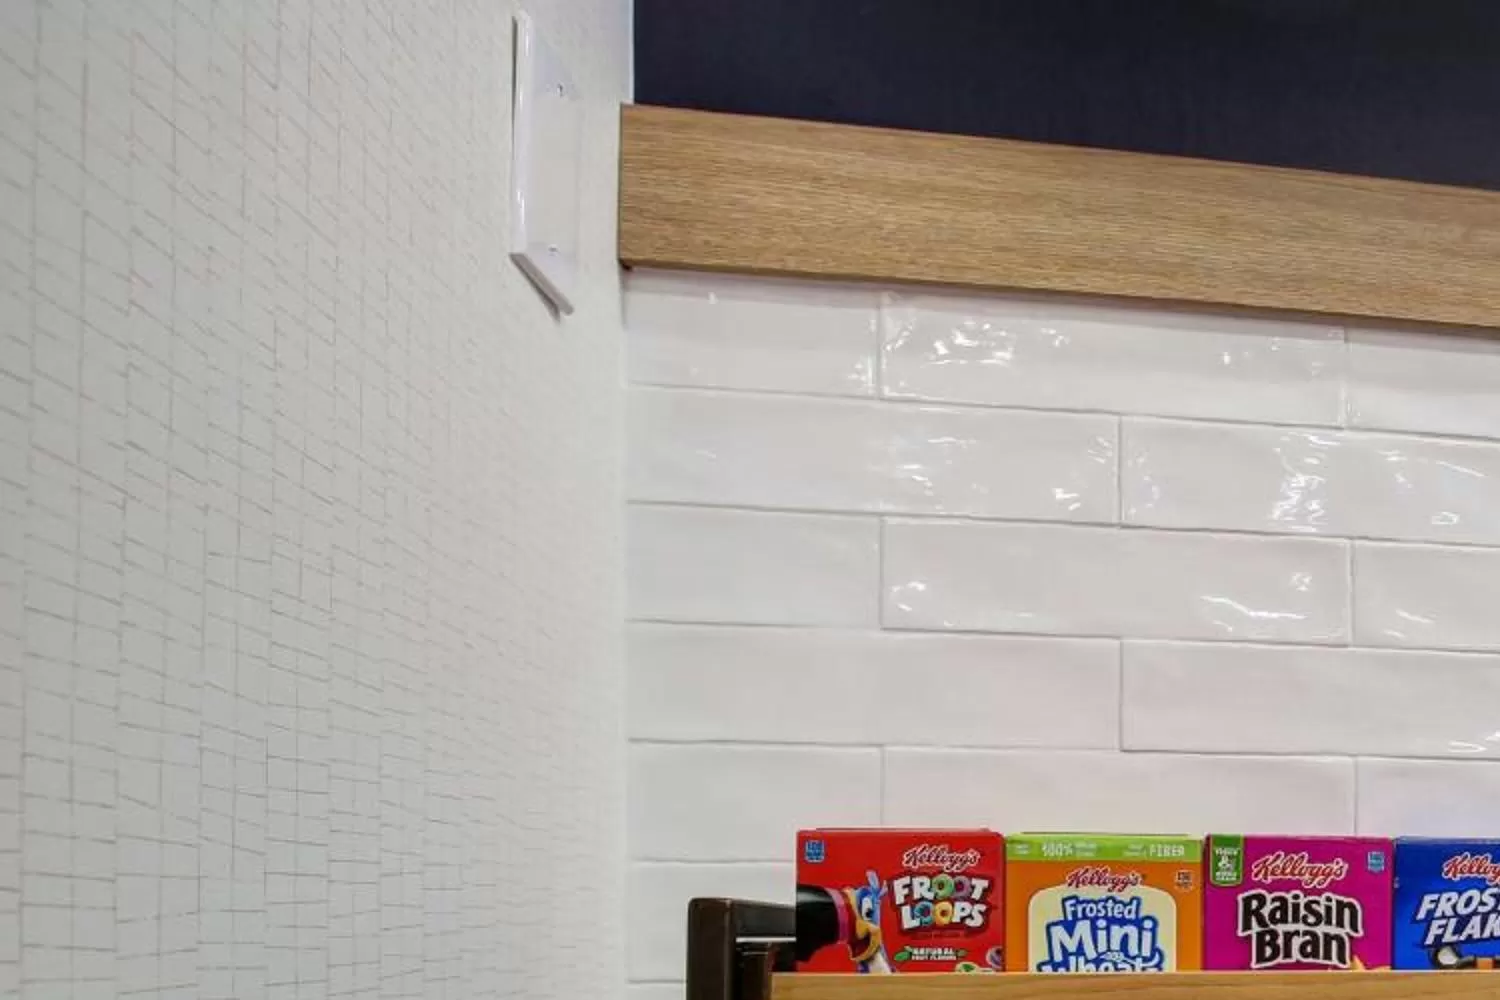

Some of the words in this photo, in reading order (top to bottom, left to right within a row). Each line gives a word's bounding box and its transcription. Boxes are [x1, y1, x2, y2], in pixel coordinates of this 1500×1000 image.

[903, 844, 980, 872] Kellogg's
[1252, 851, 1348, 888] Kellogg's
[893, 873, 990, 905] FROOT
[1066, 865, 1142, 893] Kellogg's
[901, 901, 987, 930] LOOPS
[1064, 898, 1138, 920] Frosted
[1239, 891, 1362, 935] Raisin
[1049, 919, 1154, 962] Mini
[1251, 926, 1351, 968] Bran
